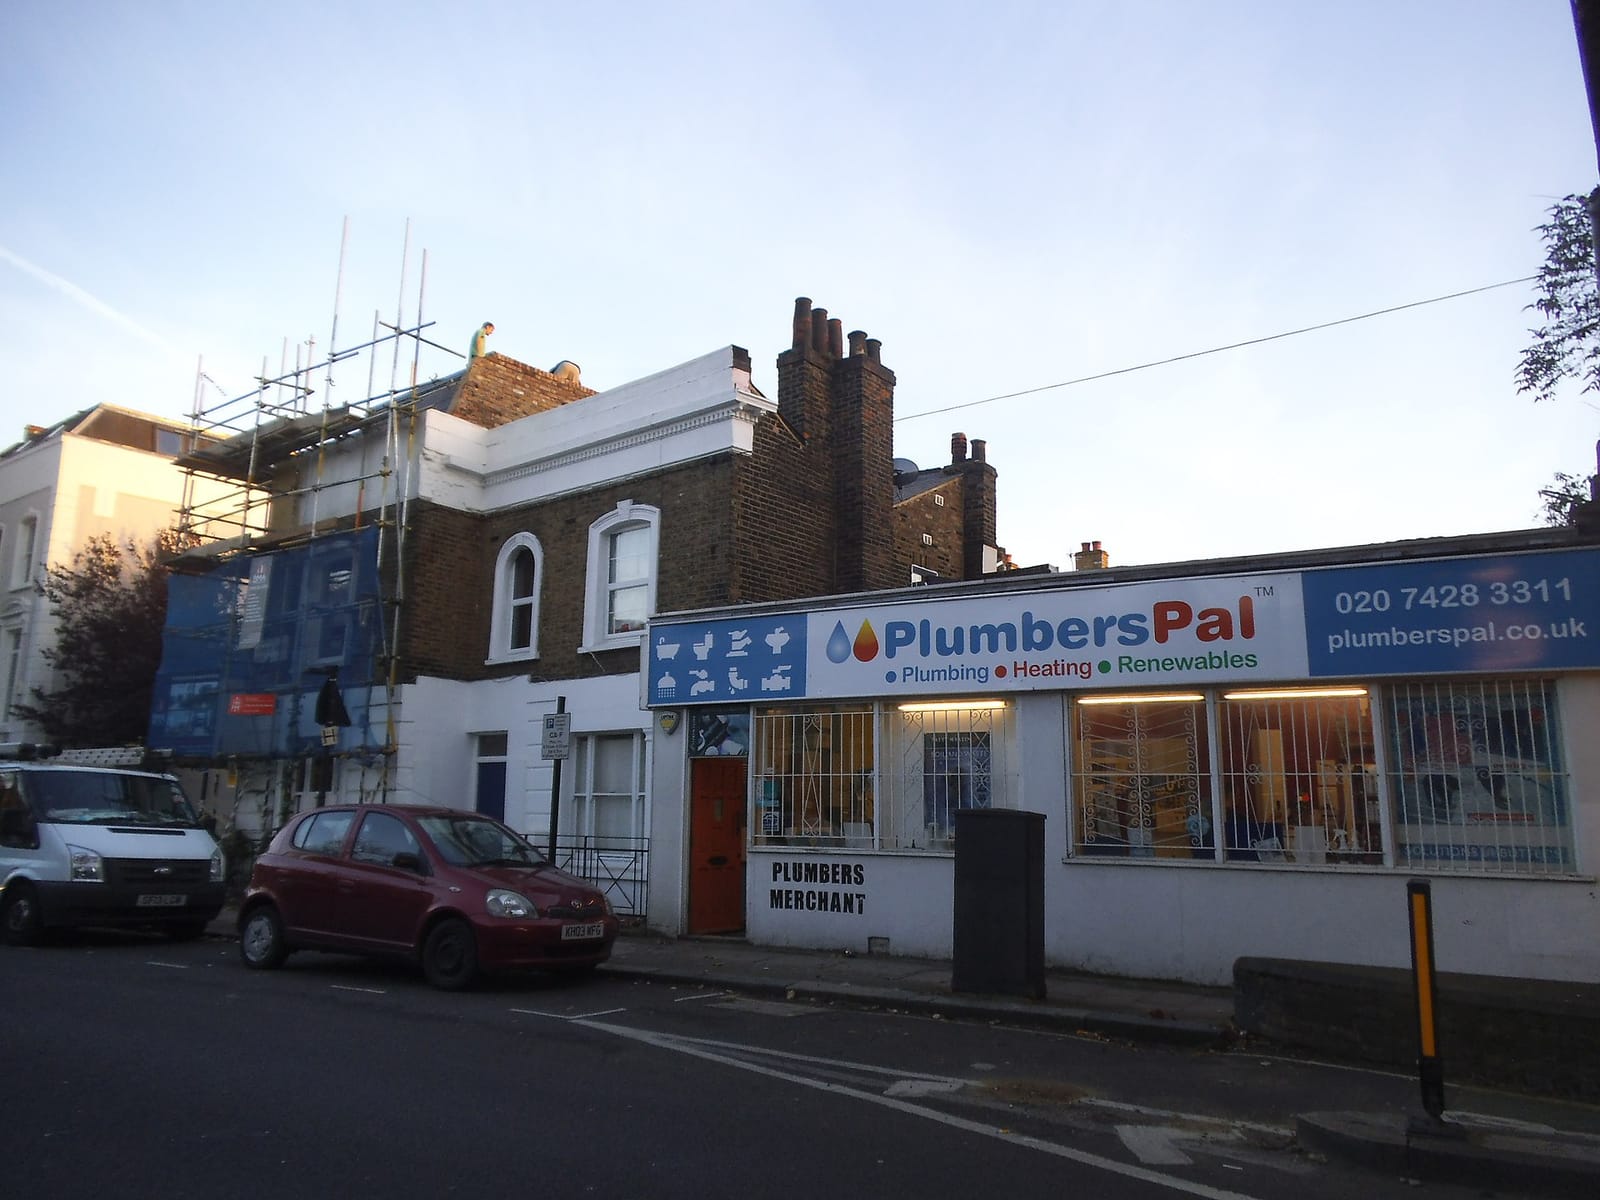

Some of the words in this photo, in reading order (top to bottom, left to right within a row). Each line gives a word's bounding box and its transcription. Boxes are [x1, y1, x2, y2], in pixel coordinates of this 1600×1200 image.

[1335, 589, 1391, 614] 020
[1401, 583, 1480, 610] 7428
[1490, 577, 1572, 605] 3311
[884, 595, 1255, 659] PlumbersPal
[1254, 586, 1274, 598] TM
[1328, 618, 1587, 654] plumberspal.co.uk
[902, 663, 989, 684] Plumbing
[1013, 659, 1092, 680] Heating
[1118, 650, 1258, 674] Renewables
[772, 861, 865, 886] PLUMBERS
[769, 889, 866, 915] MERCHANT
